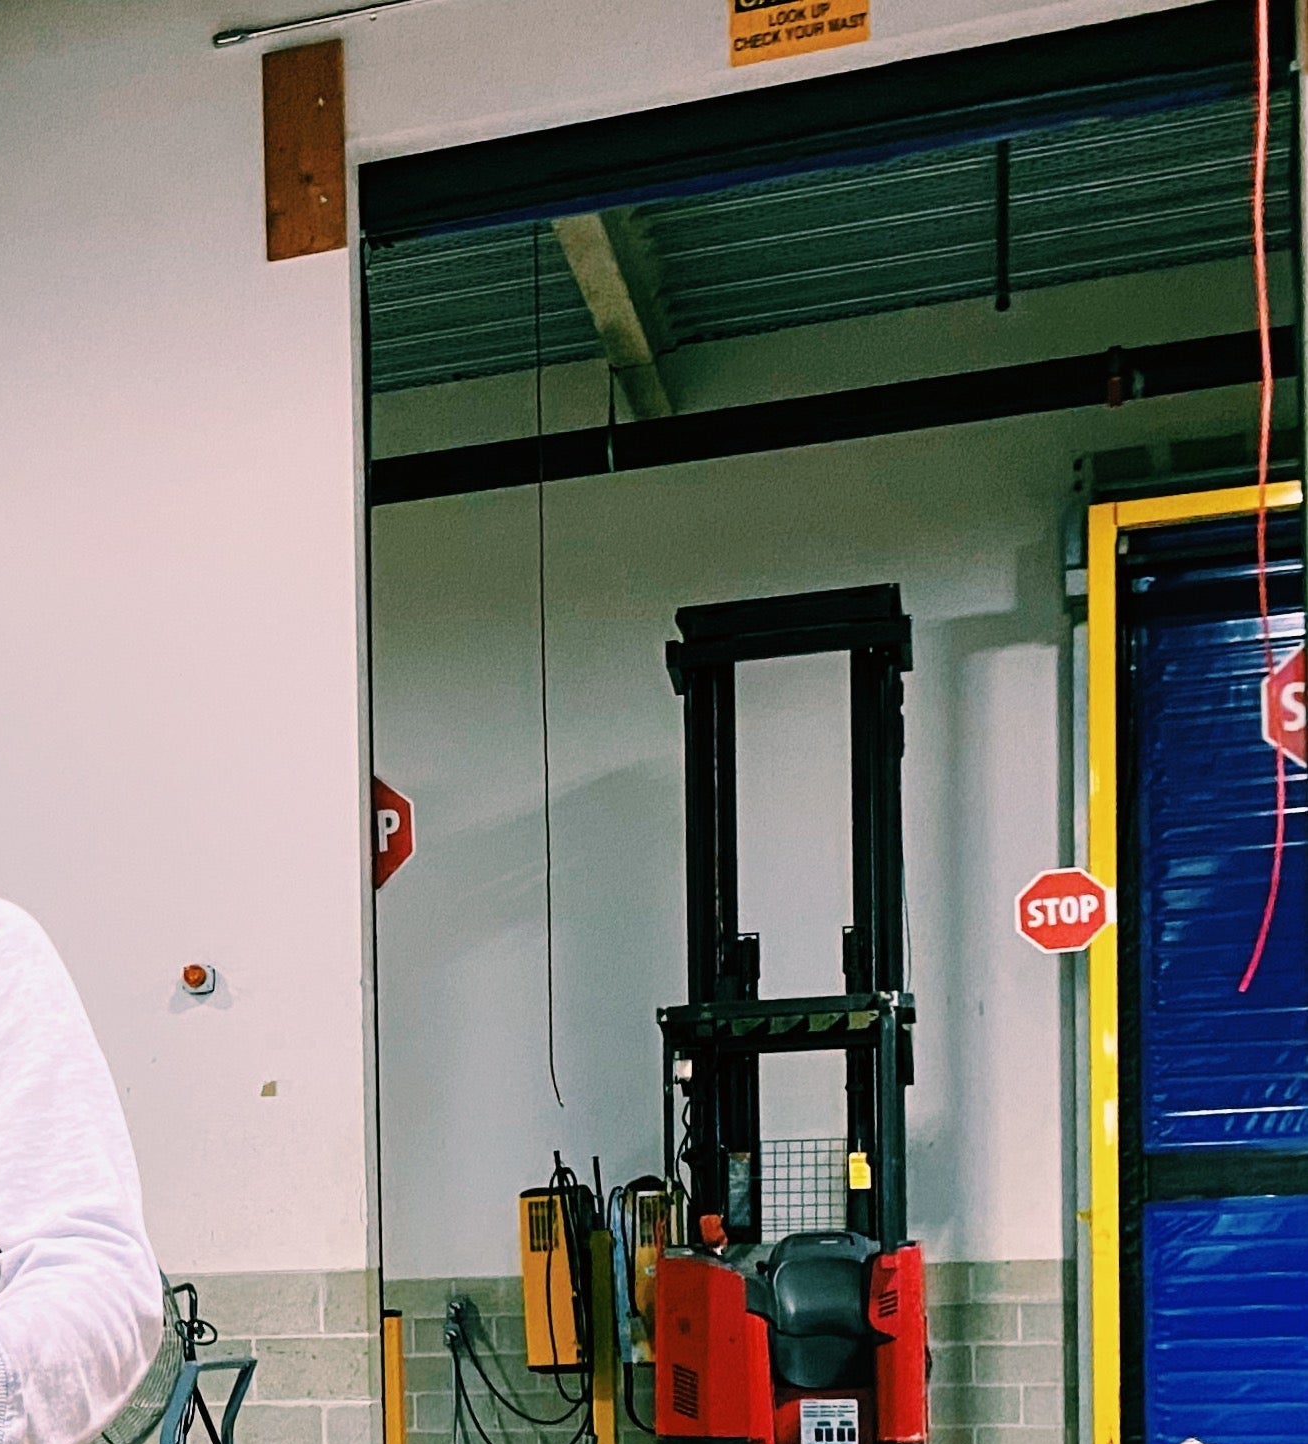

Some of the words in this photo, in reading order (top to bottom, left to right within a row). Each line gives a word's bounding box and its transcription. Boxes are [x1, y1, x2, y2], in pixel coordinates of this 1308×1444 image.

[768, 11, 806, 27] LOOK
[811, 3, 831, 19] UP
[734, 32, 782, 51] CHECK
[785, 22, 824, 41] YOUR
[1028, 893, 1098, 927] STOP
